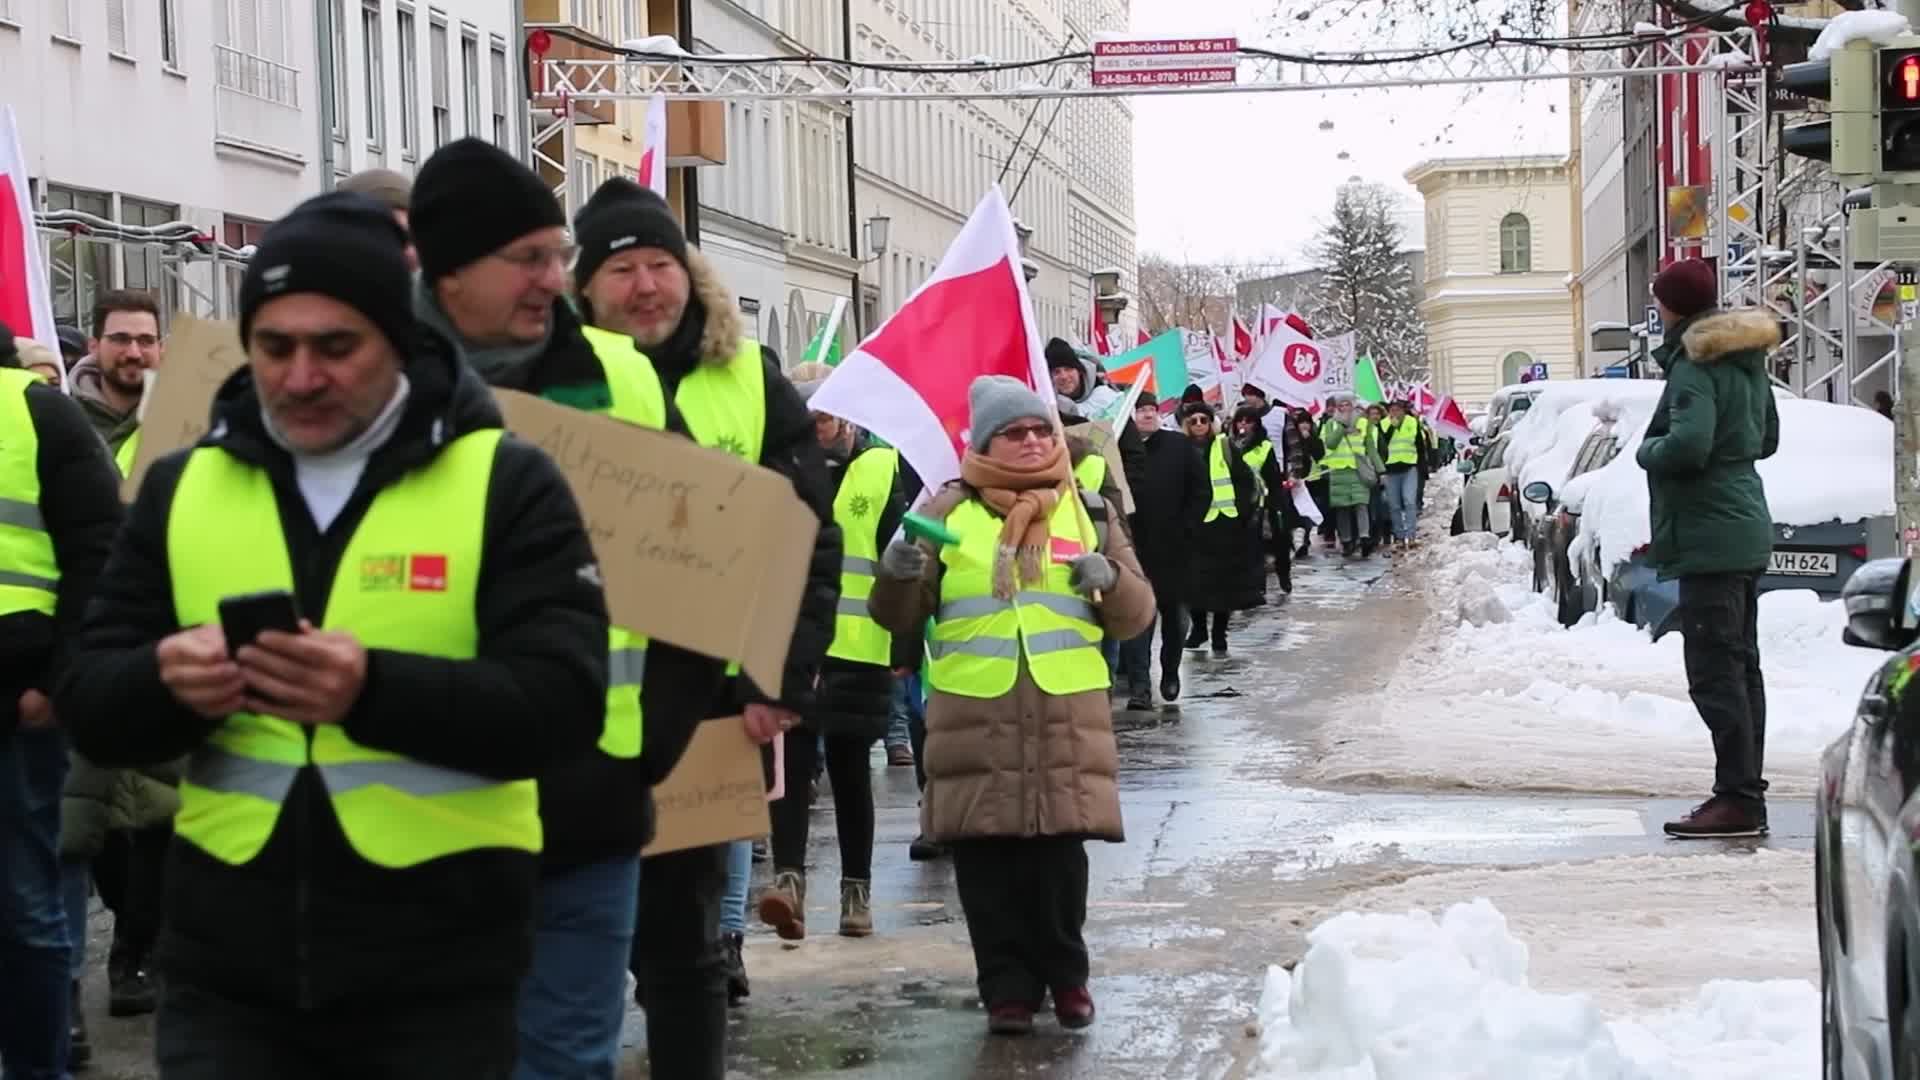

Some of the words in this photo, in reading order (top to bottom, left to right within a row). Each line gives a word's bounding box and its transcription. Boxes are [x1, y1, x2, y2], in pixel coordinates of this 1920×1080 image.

[1102, 42, 1176, 54] Kabelbrücken
[1179, 41, 1196, 52] bis
[1198, 40, 1212, 51] 45
[1213, 42, 1225, 51] m
[1648, 309, 1658, 332] P
[1535, 365, 1544, 379] P
[1799, 555, 1829, 570] 624
